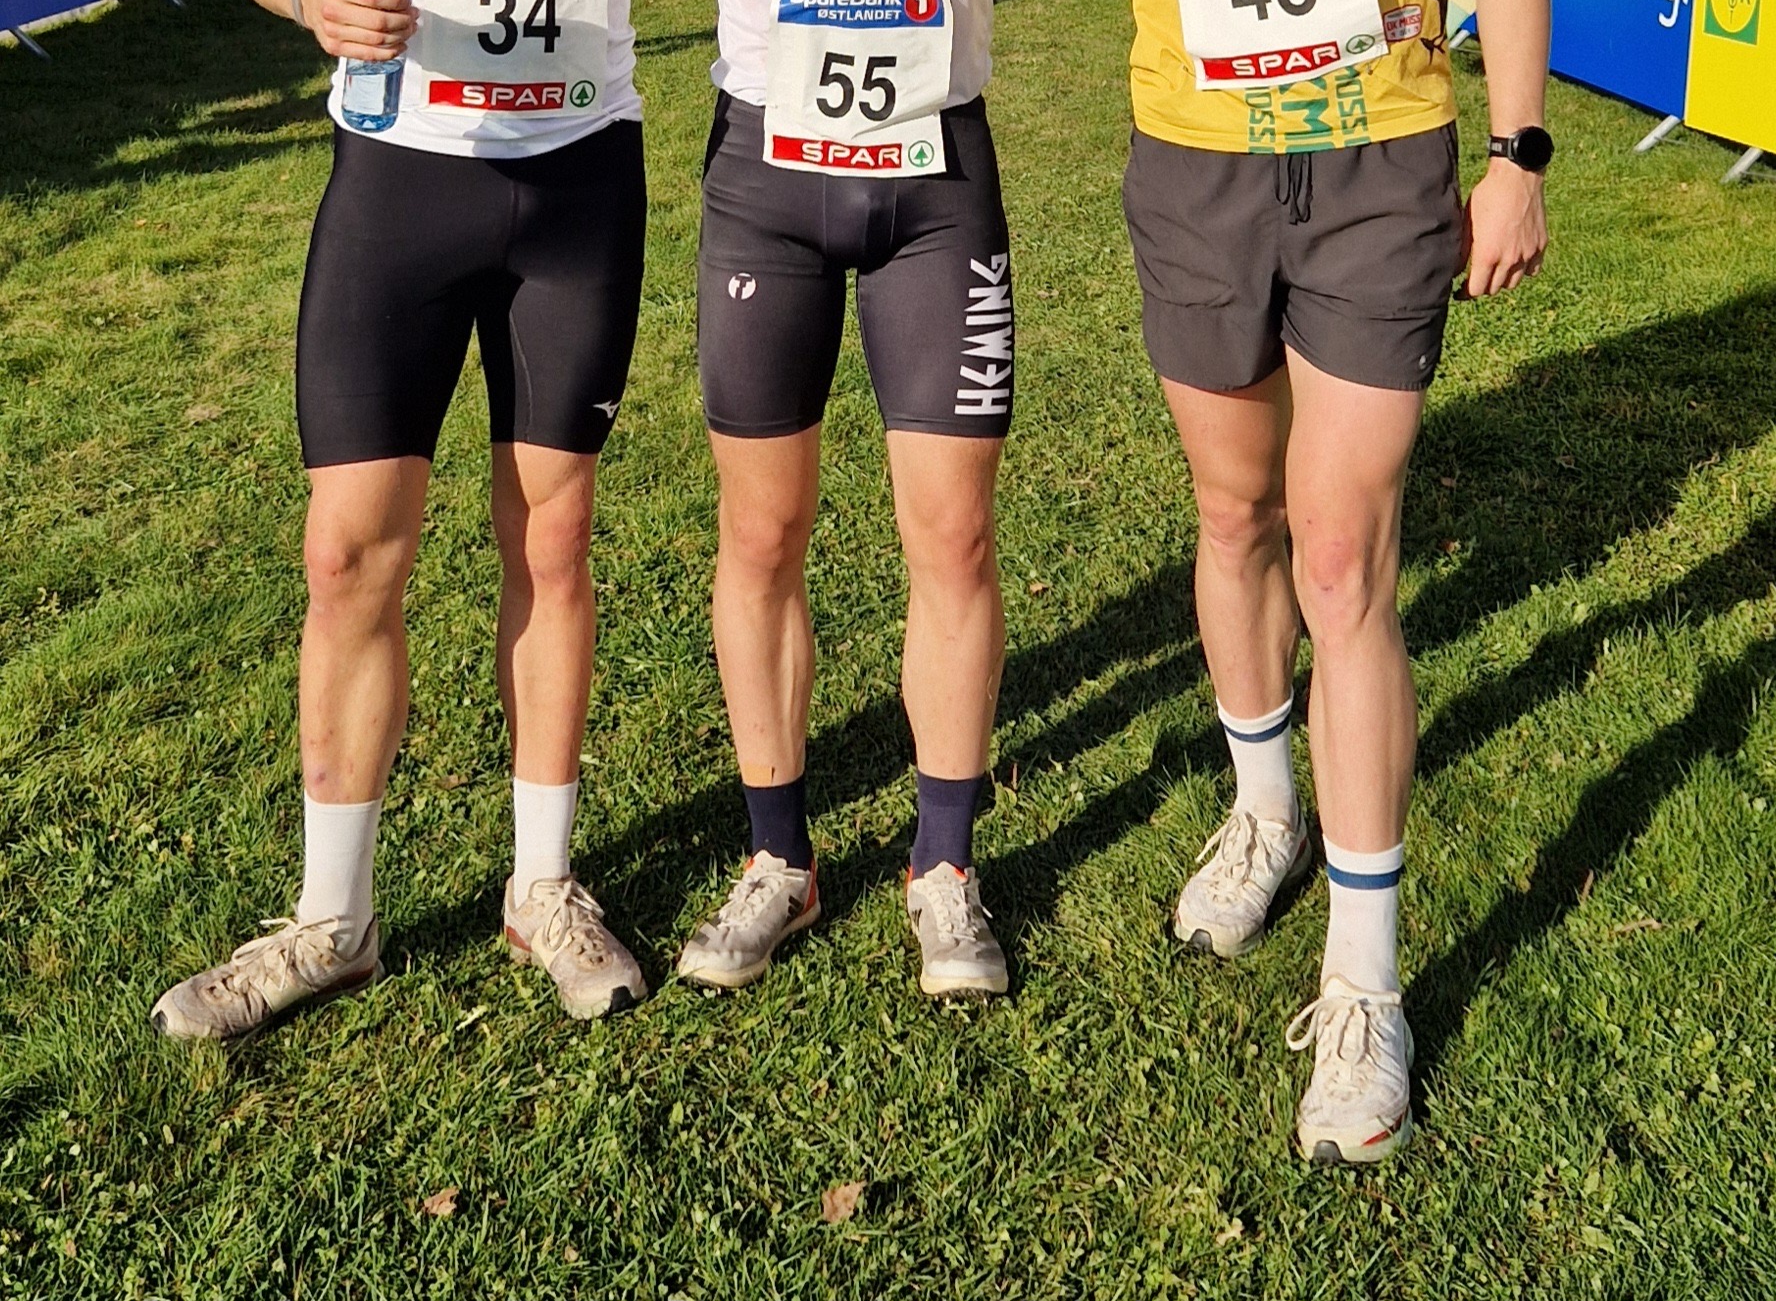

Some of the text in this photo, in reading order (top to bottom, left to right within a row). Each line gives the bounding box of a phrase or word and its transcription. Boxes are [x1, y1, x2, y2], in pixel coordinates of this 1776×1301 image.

[817, 9, 902, 21] ØSTLANDET
[1231, 46, 1338, 77] SPAR
[462, 85, 563, 107] SPAR
[816, 51, 898, 121] 55
[801, 141, 900, 166] SPAR
[954, 252, 1012, 416] HEMING
